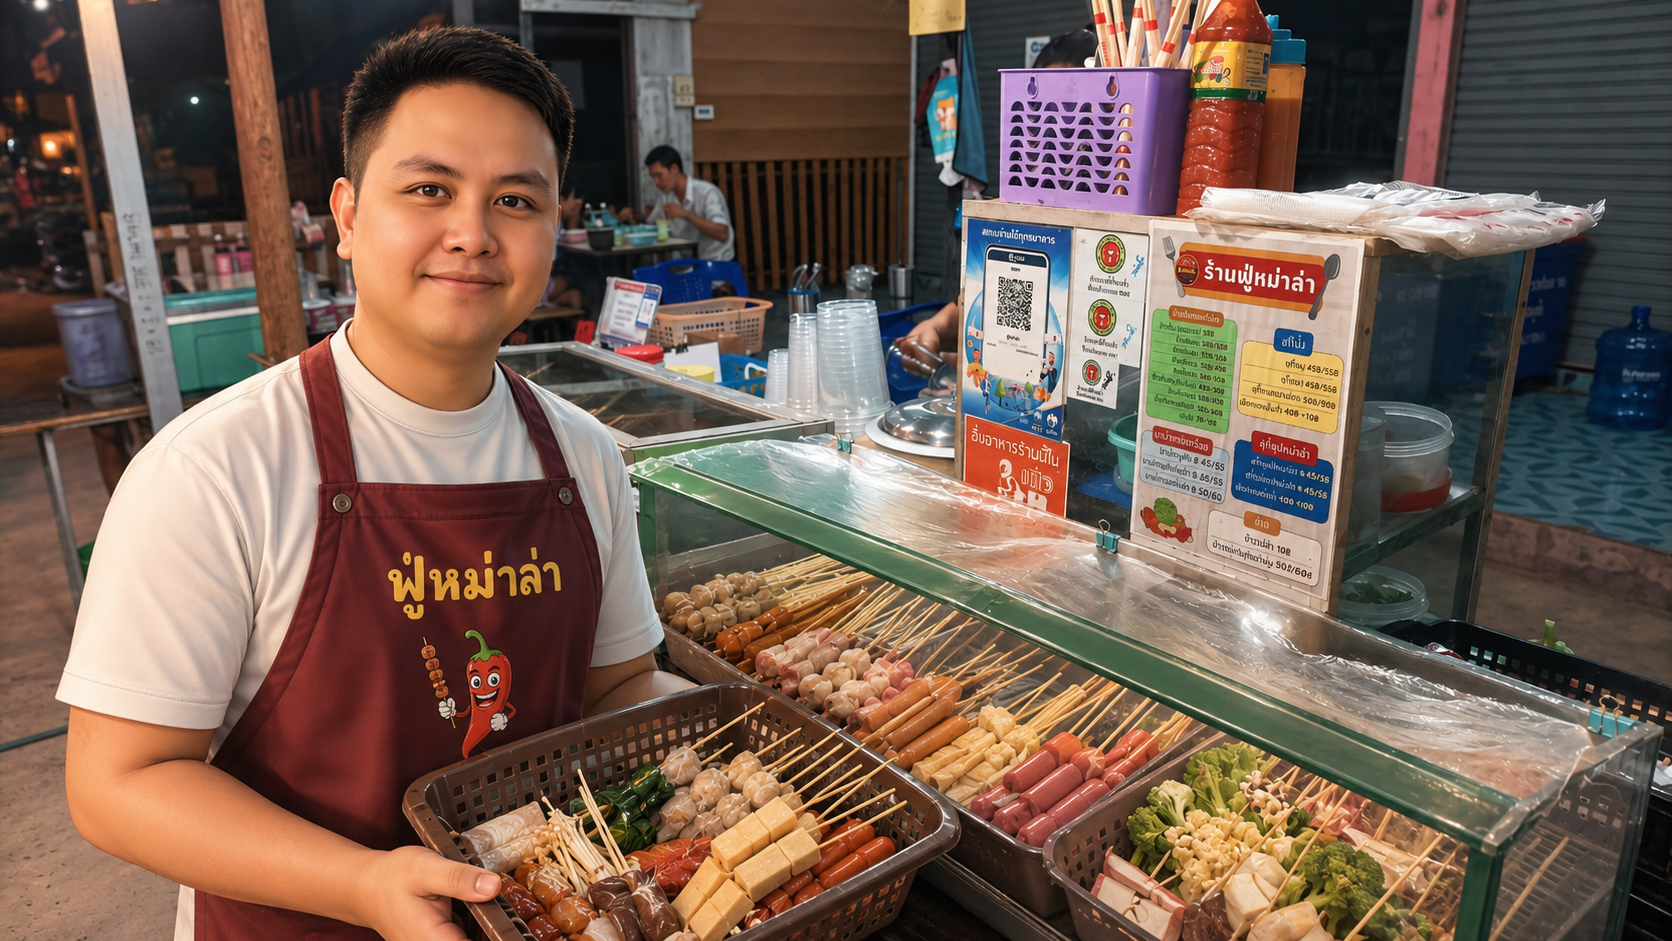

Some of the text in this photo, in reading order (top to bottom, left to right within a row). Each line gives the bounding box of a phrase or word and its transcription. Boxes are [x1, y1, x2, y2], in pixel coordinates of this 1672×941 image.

[1204, 259, 1315, 294] ร้านฟู่หม่าล่า
[387, 546, 562, 620] ฟู่หม่าล่า
